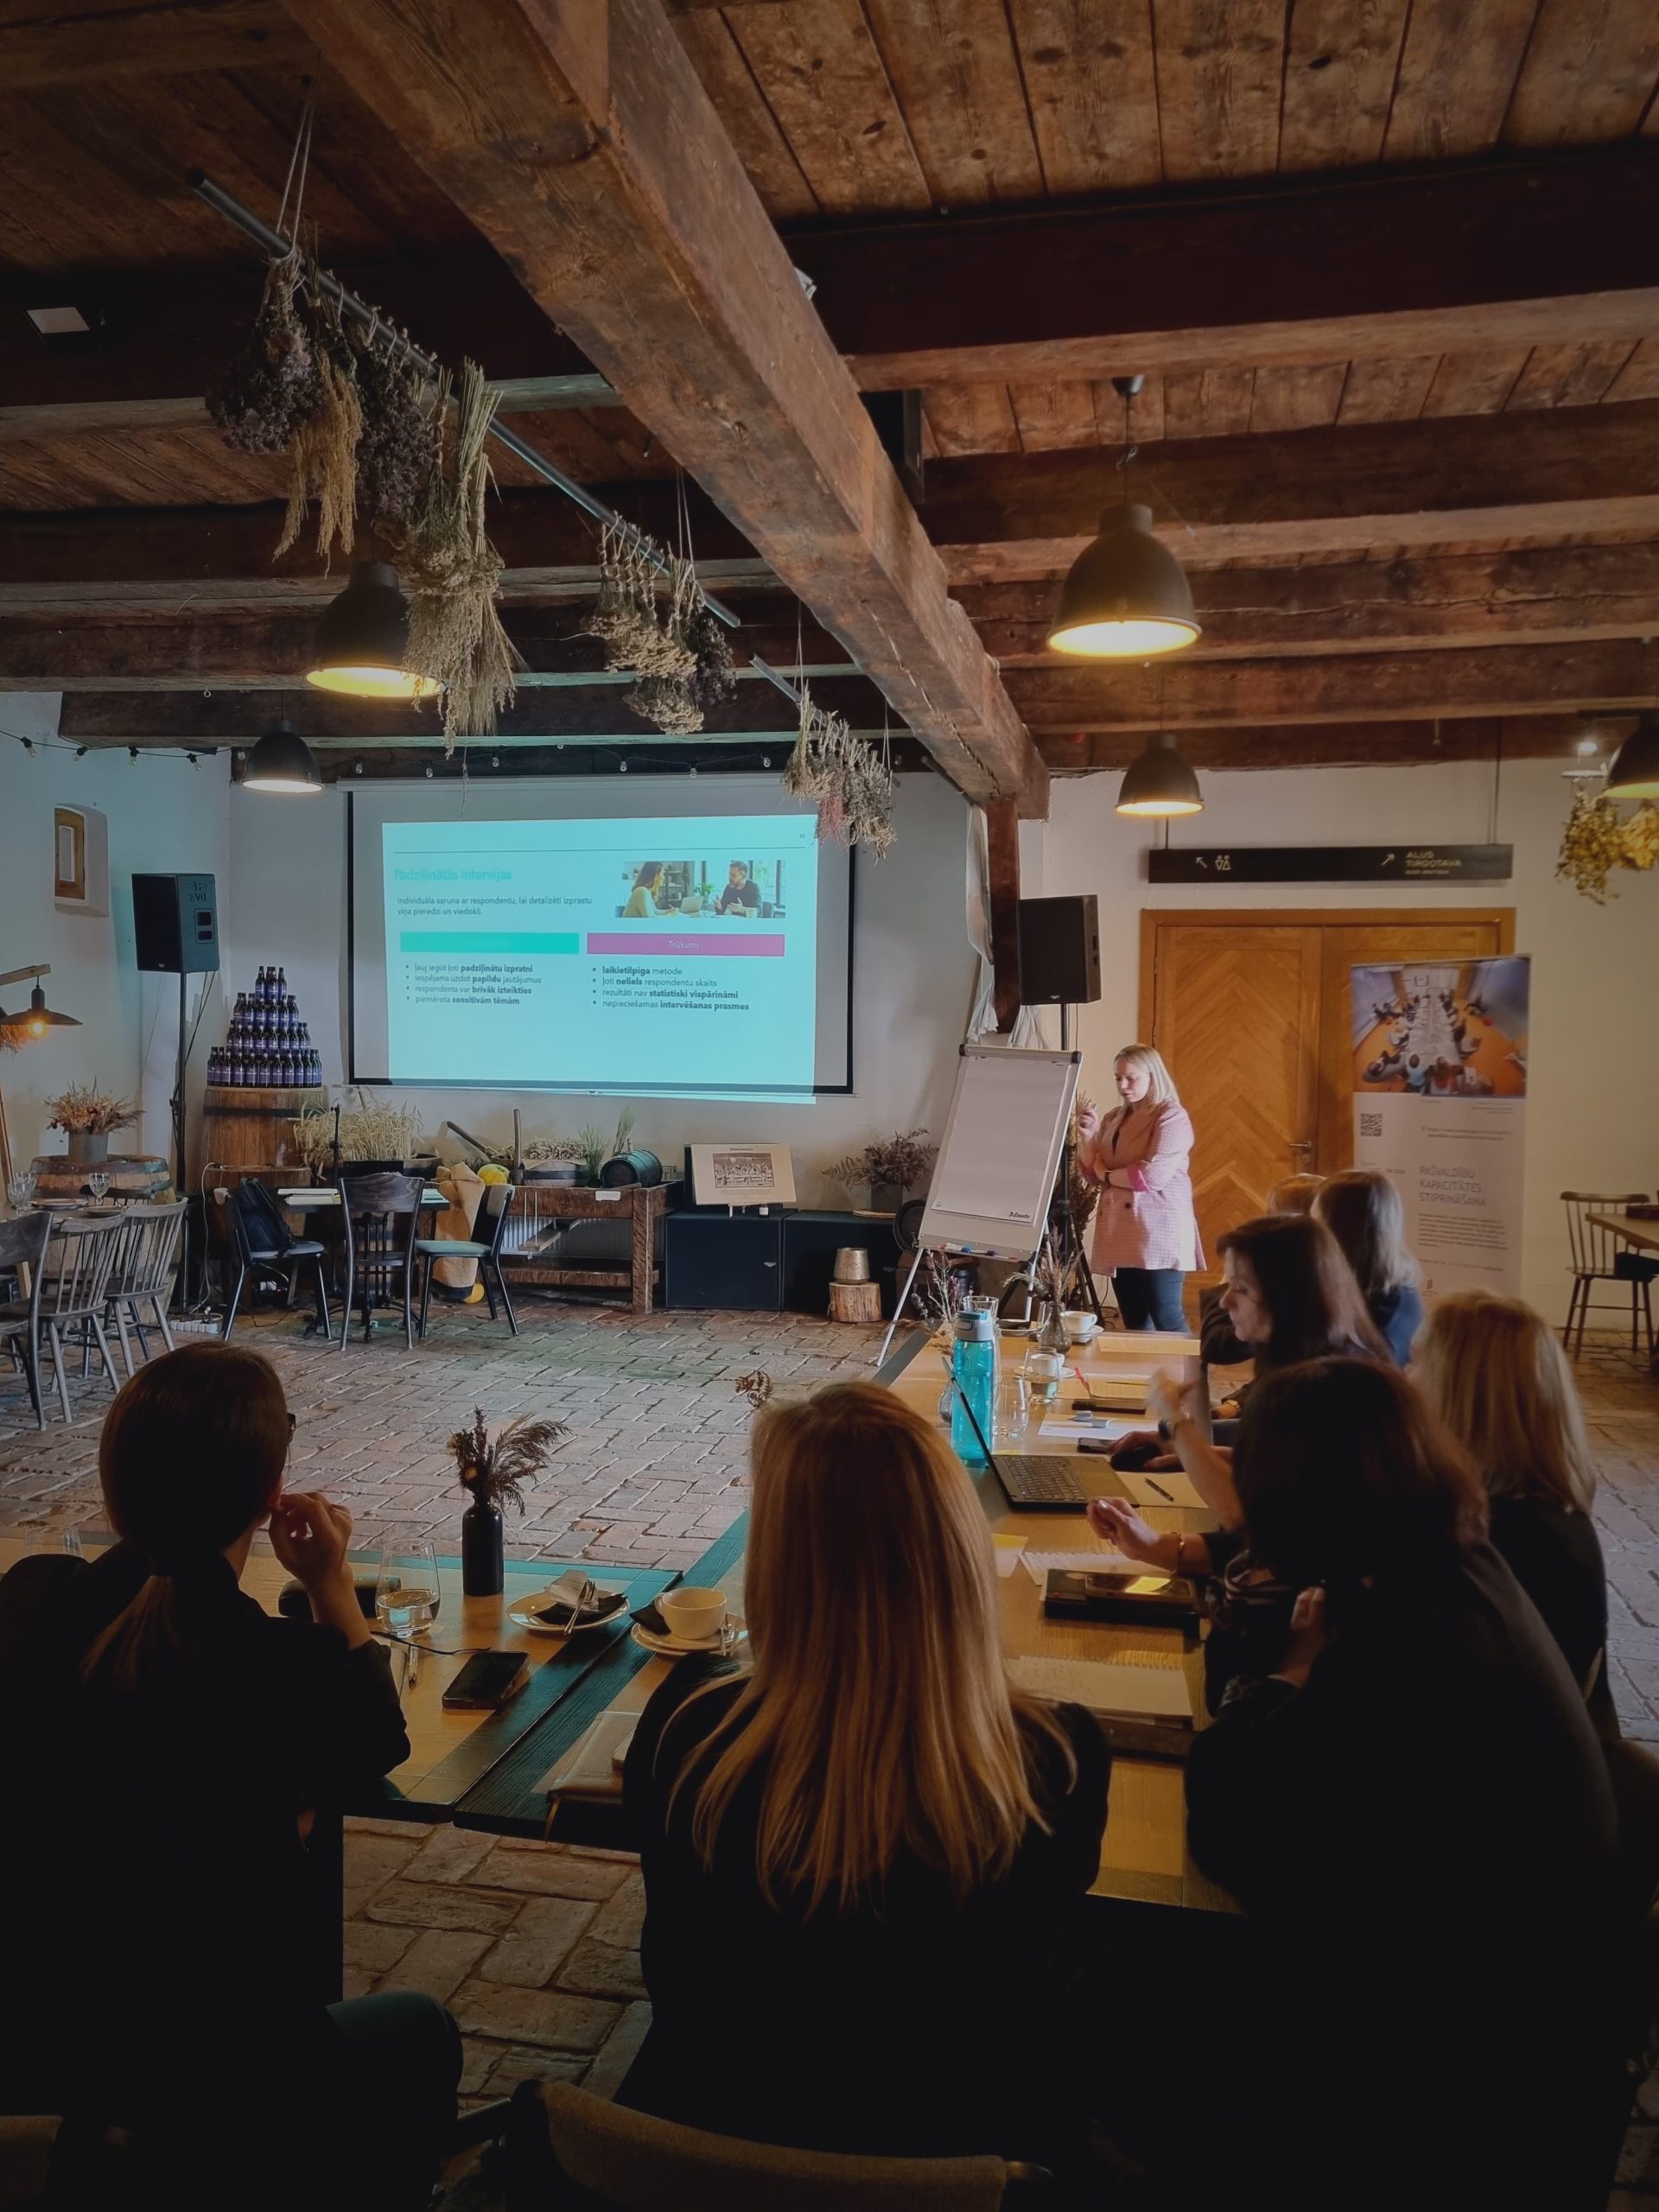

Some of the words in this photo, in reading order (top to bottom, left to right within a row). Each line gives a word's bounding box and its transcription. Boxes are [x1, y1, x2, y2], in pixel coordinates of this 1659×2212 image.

[461, 868, 512, 882] intervijas
[397, 896, 435, 905] Individuāla
[470, 897, 518, 906] respondentu,
[518, 896, 527, 905] lai
[529, 896, 562, 905] detalizēti
[563, 897, 592, 906] izprastu
[397, 908, 411, 917] viņa
[413, 907, 441, 917] pieredzi
[668, 940, 699, 949] Trūkumi
[415, 963, 427, 973] ļauj
[429, 964, 447, 974] iegūt
[448, 963, 459, 973] ļoti
[461, 964, 502, 974] padziļinātu
[504, 964, 533, 974] izpratni
[652, 967, 683, 976] metode
[415, 974, 450, 983] iespējams
[472, 976, 501, 984] papildu
[502, 976, 542, 986] jautājumus
[602, 977, 614, 987] ļoti
[616, 977, 643, 986] neliels
[644, 978, 694, 988] respondentu
[695, 979, 717, 988] skaits
[415, 985, 458, 995] respondents
[497, 986, 531, 995] izteikties
[602, 988, 632, 997] rezultāti
[649, 989, 688, 998] statistiski
[690, 990, 739, 1001] vispārināmi
[416, 995, 451, 1005] piemērota
[493, 996, 519, 1006] tēmām
[602, 999, 658, 1009] nepieciešamas
[660, 1000, 712, 1010] intervēšanas
[714, 1002, 749, 1012] prasmes
[1419, 1164, 1476, 1179] PAŠVALDĪBU
[1419, 1179, 1482, 1193] KAPACITĀTES
